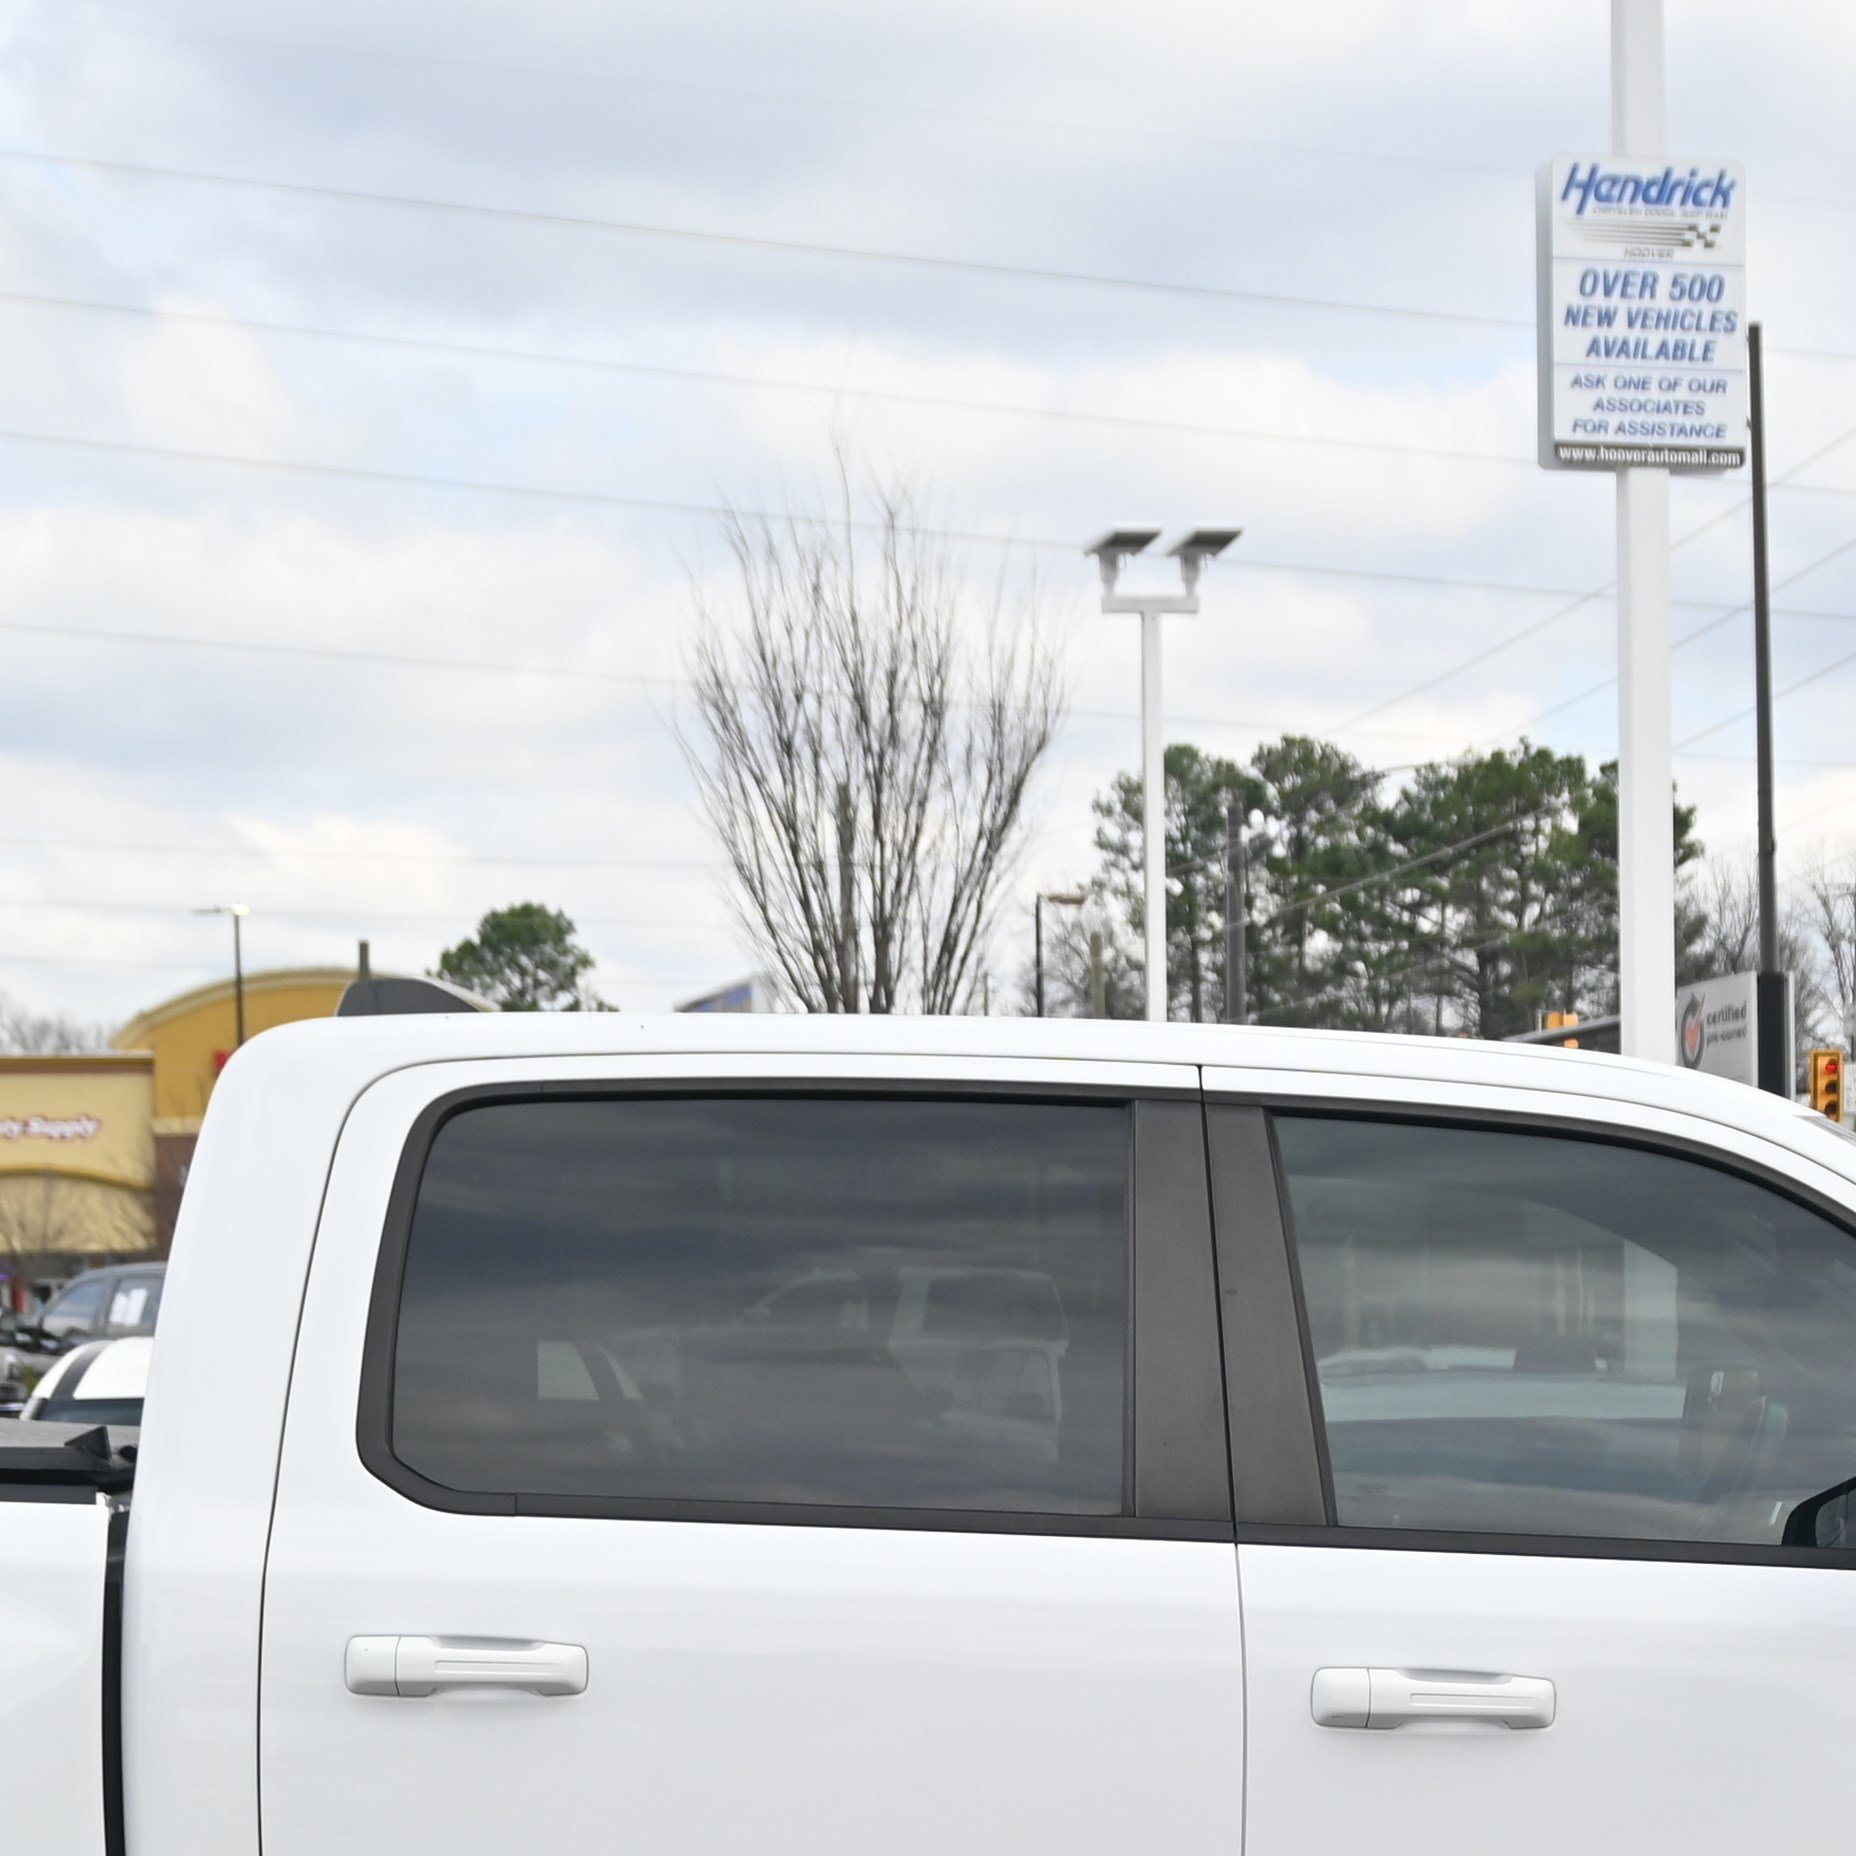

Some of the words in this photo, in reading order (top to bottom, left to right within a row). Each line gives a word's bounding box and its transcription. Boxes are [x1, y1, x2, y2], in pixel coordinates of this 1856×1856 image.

[1561, 162, 1737, 216] Hendrick
[1624, 247, 1674, 260] HOOVER
[1579, 268, 1659, 301] OVER
[1669, 273, 1726, 304] 500
[1564, 304, 1619, 329] NEW
[1626, 307, 1739, 334] VEHICLES
[1585, 335, 1717, 363] AVAILABLE
[1570, 374, 1607, 391] ASK
[1613, 375, 1651, 392] ONE
[1658, 377, 1684, 393] OF
[1688, 378, 1728, 395] OUR
[1592, 397, 1706, 416] ASSOCIATES
[1572, 418, 1609, 435] FOR
[1614, 420, 1727, 439] ASSISTANCE
[1558, 444, 1741, 467] www.hooverautomall.com
[1706, 1000, 1747, 1025] certified
